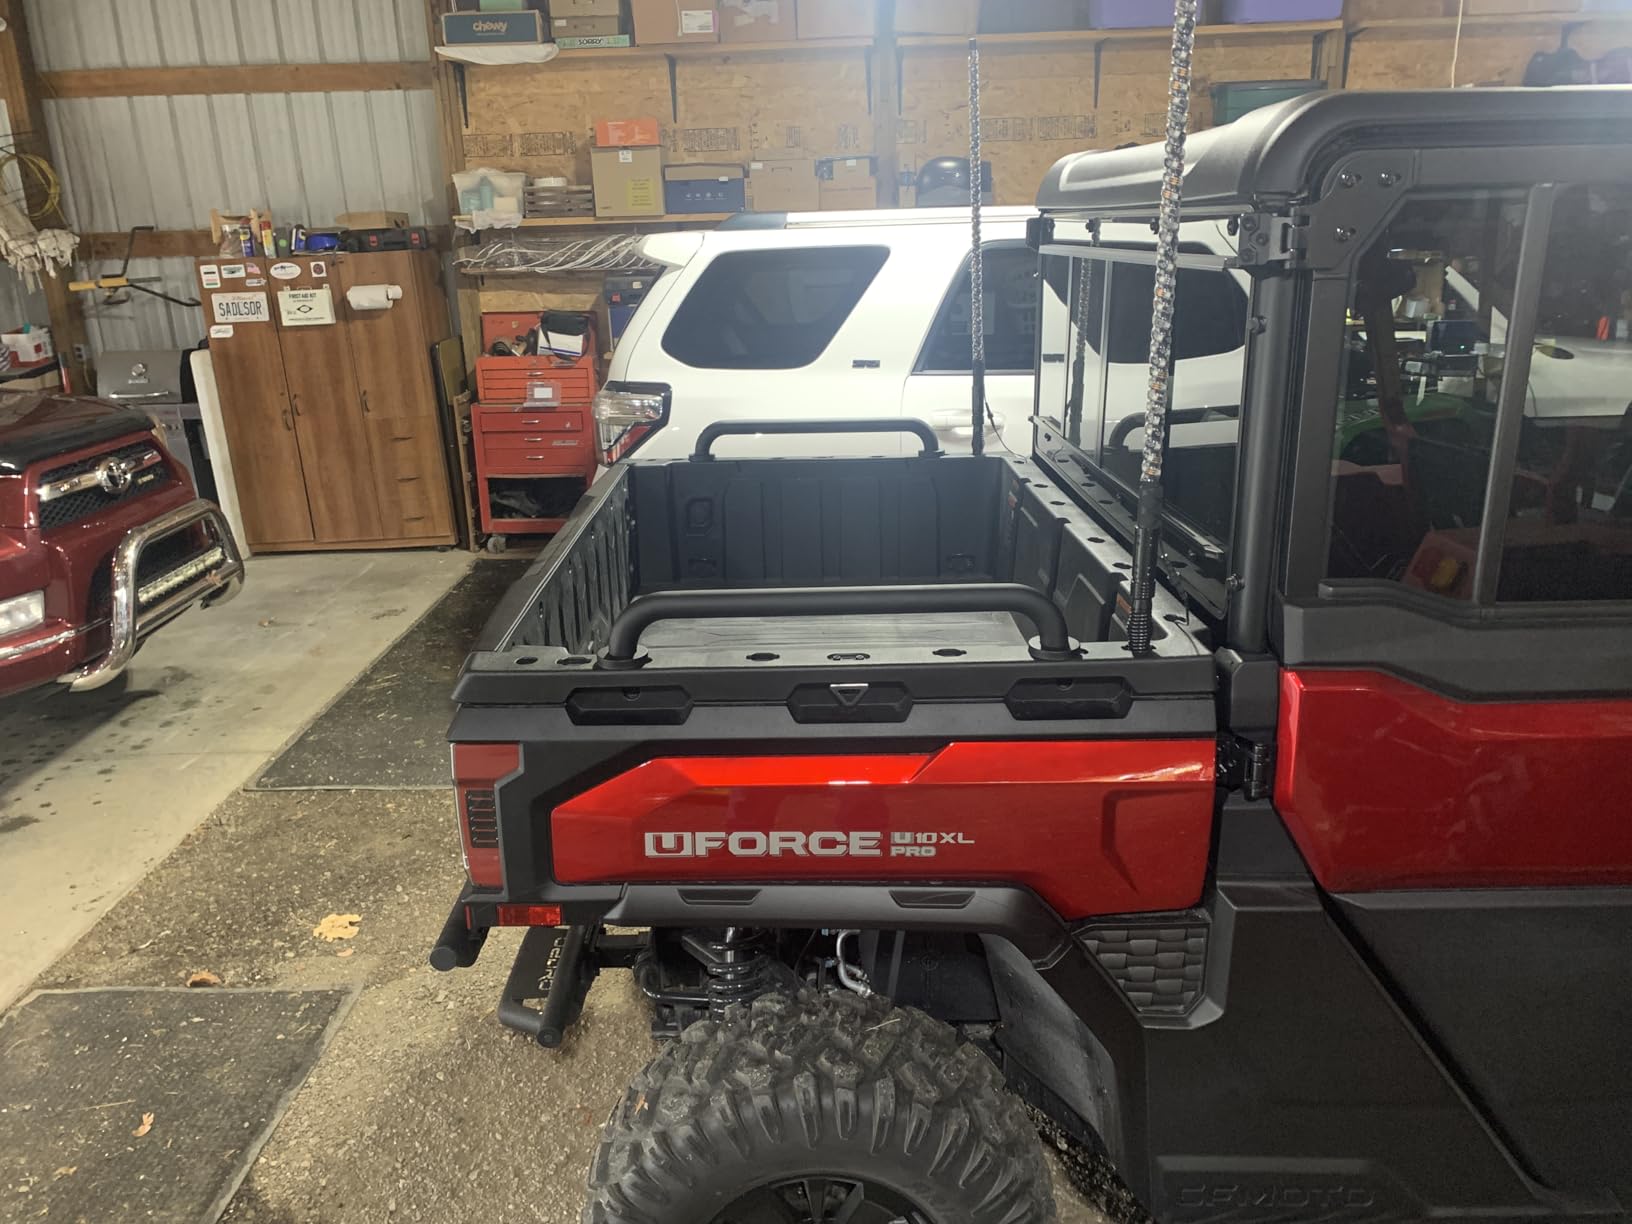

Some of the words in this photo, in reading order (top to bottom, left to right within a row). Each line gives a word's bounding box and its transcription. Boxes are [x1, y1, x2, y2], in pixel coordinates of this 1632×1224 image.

[473, 20, 508, 33] chewy
[644, 831, 883, 858] UFORCE
[890, 845, 937, 857] PRO
